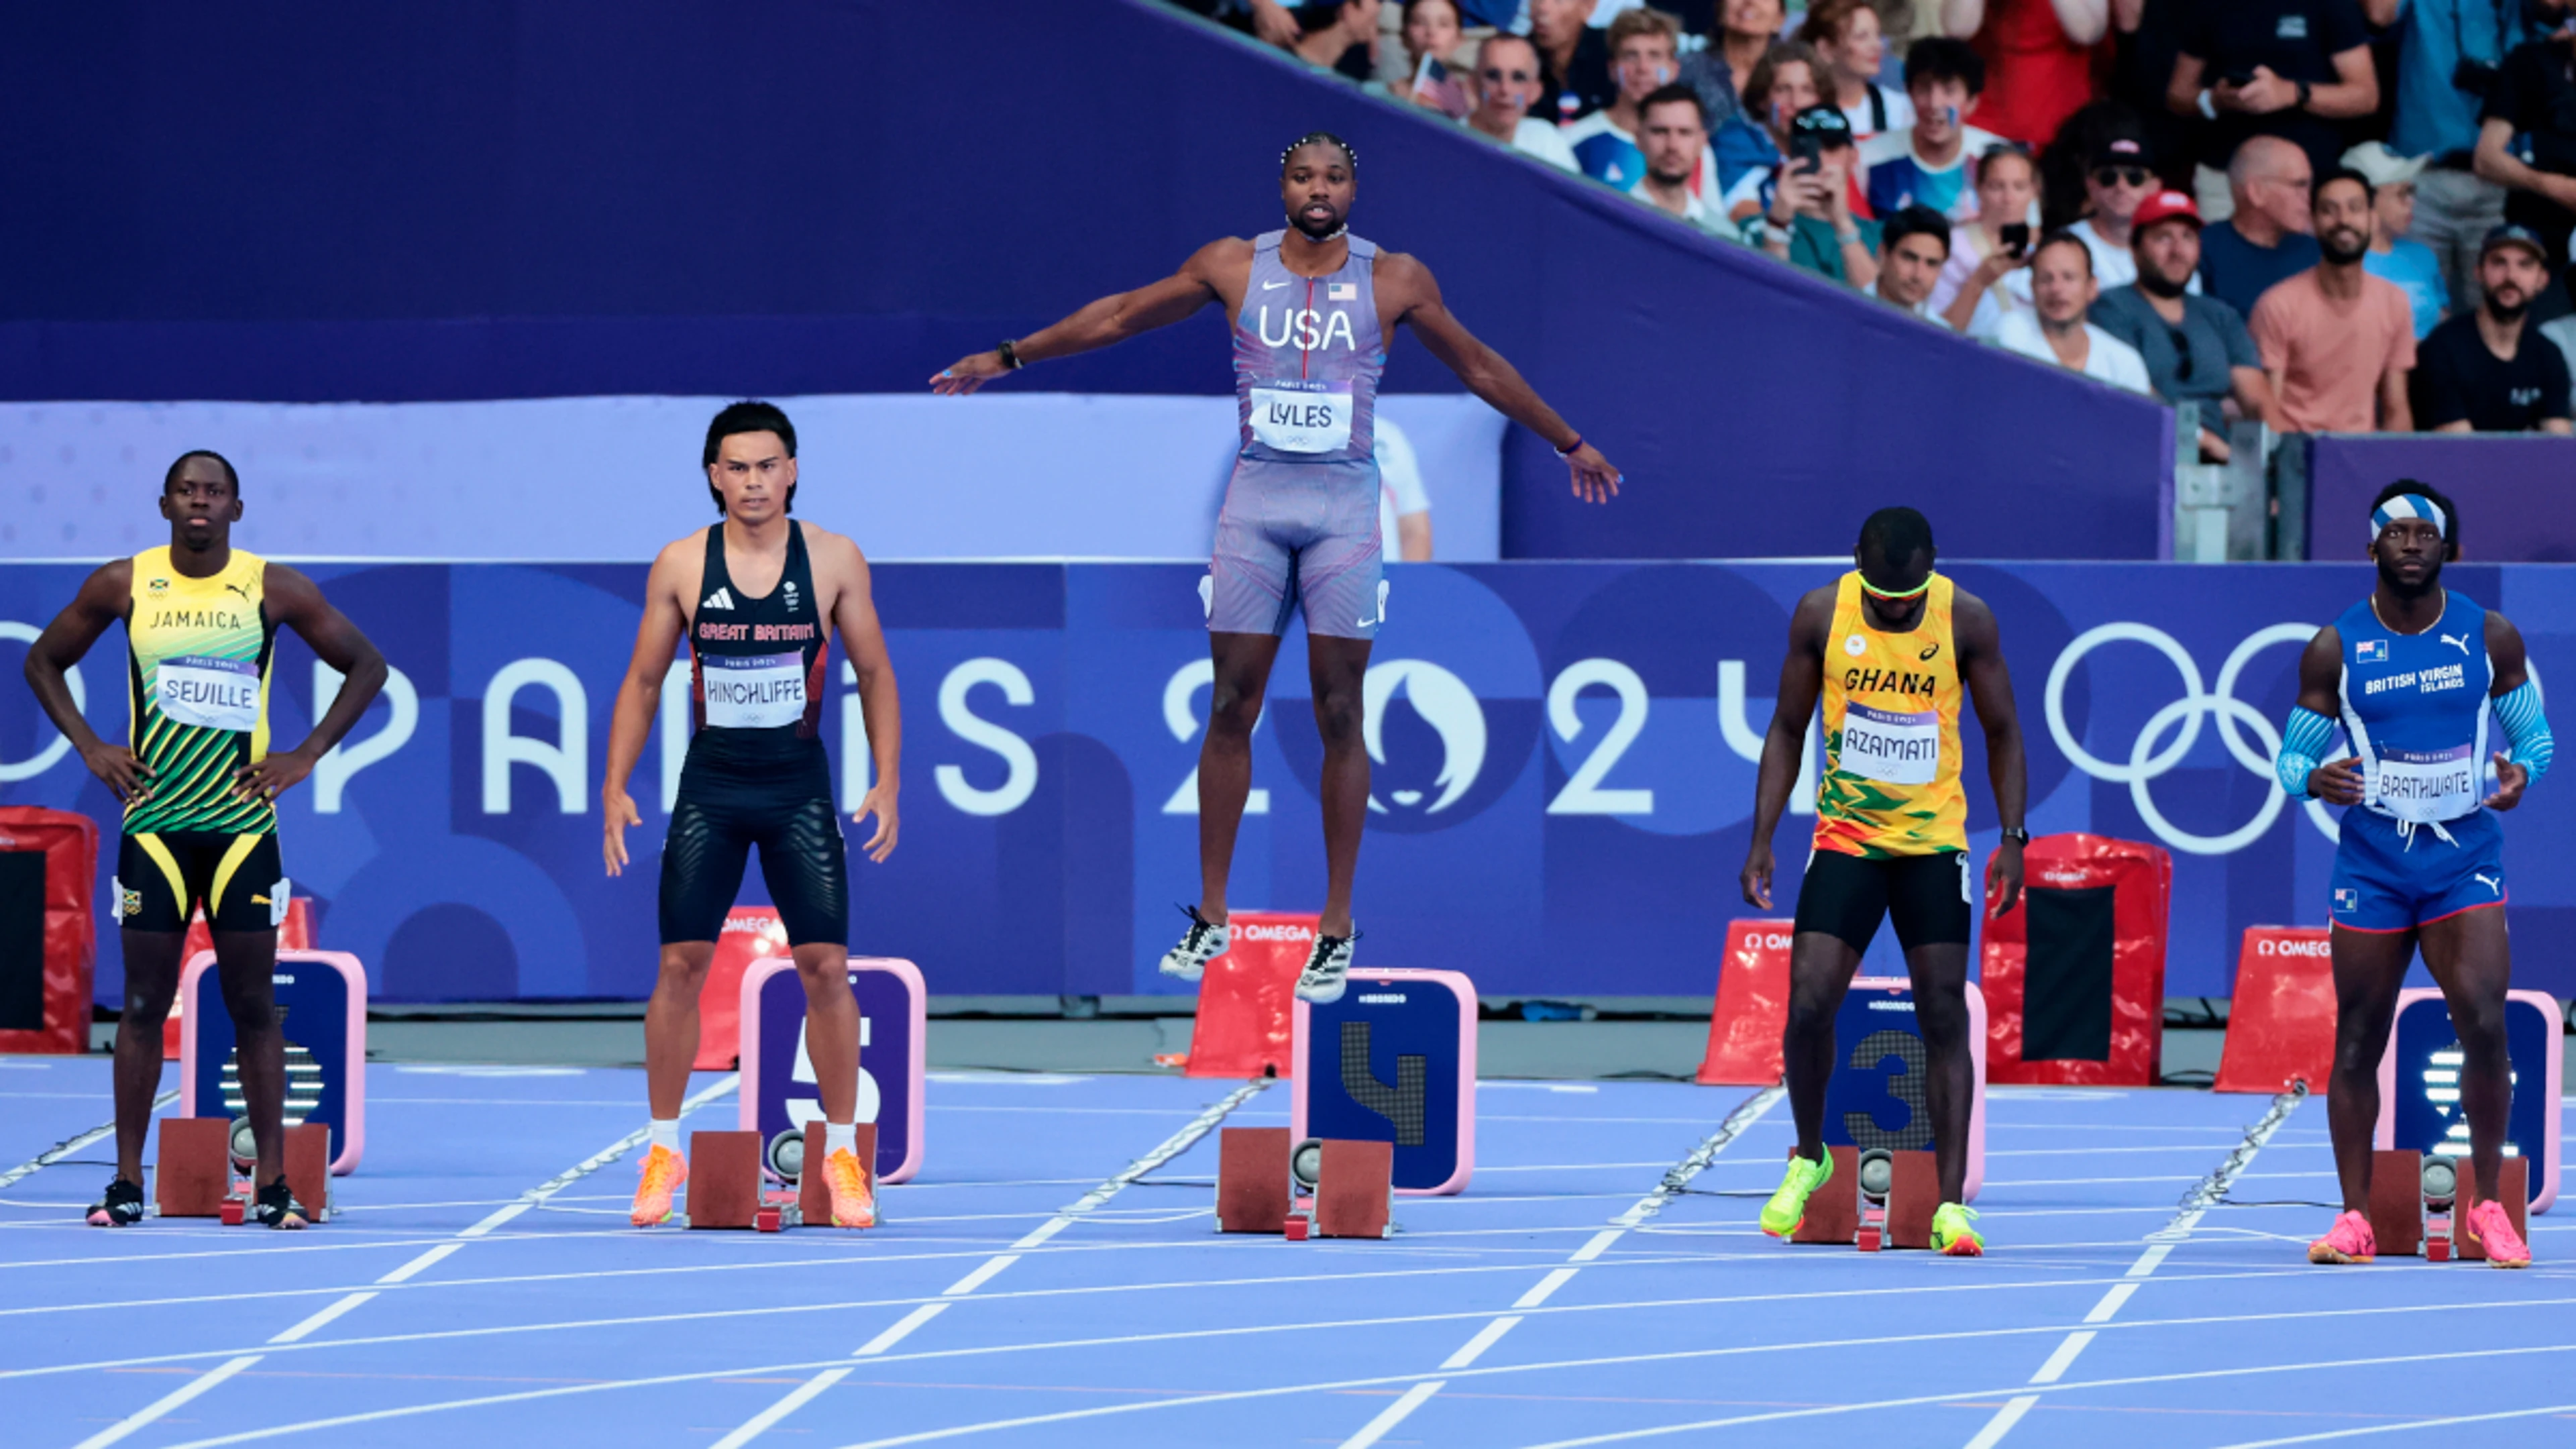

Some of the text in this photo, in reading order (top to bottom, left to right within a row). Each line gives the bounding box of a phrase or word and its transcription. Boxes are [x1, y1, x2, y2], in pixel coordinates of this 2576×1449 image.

[1259, 305, 1356, 351] USA
[1269, 401, 1332, 428] LYLES
[150, 611, 241, 630] JAMAICA
[699, 622, 814, 641] GREAT BRITAIN
[707, 678, 803, 705] HINCHLIFFE
[1845, 668, 1935, 698] GHANA
[2365, 663, 2463, 695] BRITISH VIRGIN
[2420, 678, 2465, 694] ISLANDS
[165, 679, 254, 710] SEVILLE
[1845, 727, 1935, 761] AZAMATI
[2381, 771, 2470, 800] BRATHWAITE
[1245, 924, 1312, 941] OMEGA
[2277, 939, 2332, 957] OMEG
[1341, 1021, 1426, 1146] 4
[1843, 1030, 1935, 1151] 3
